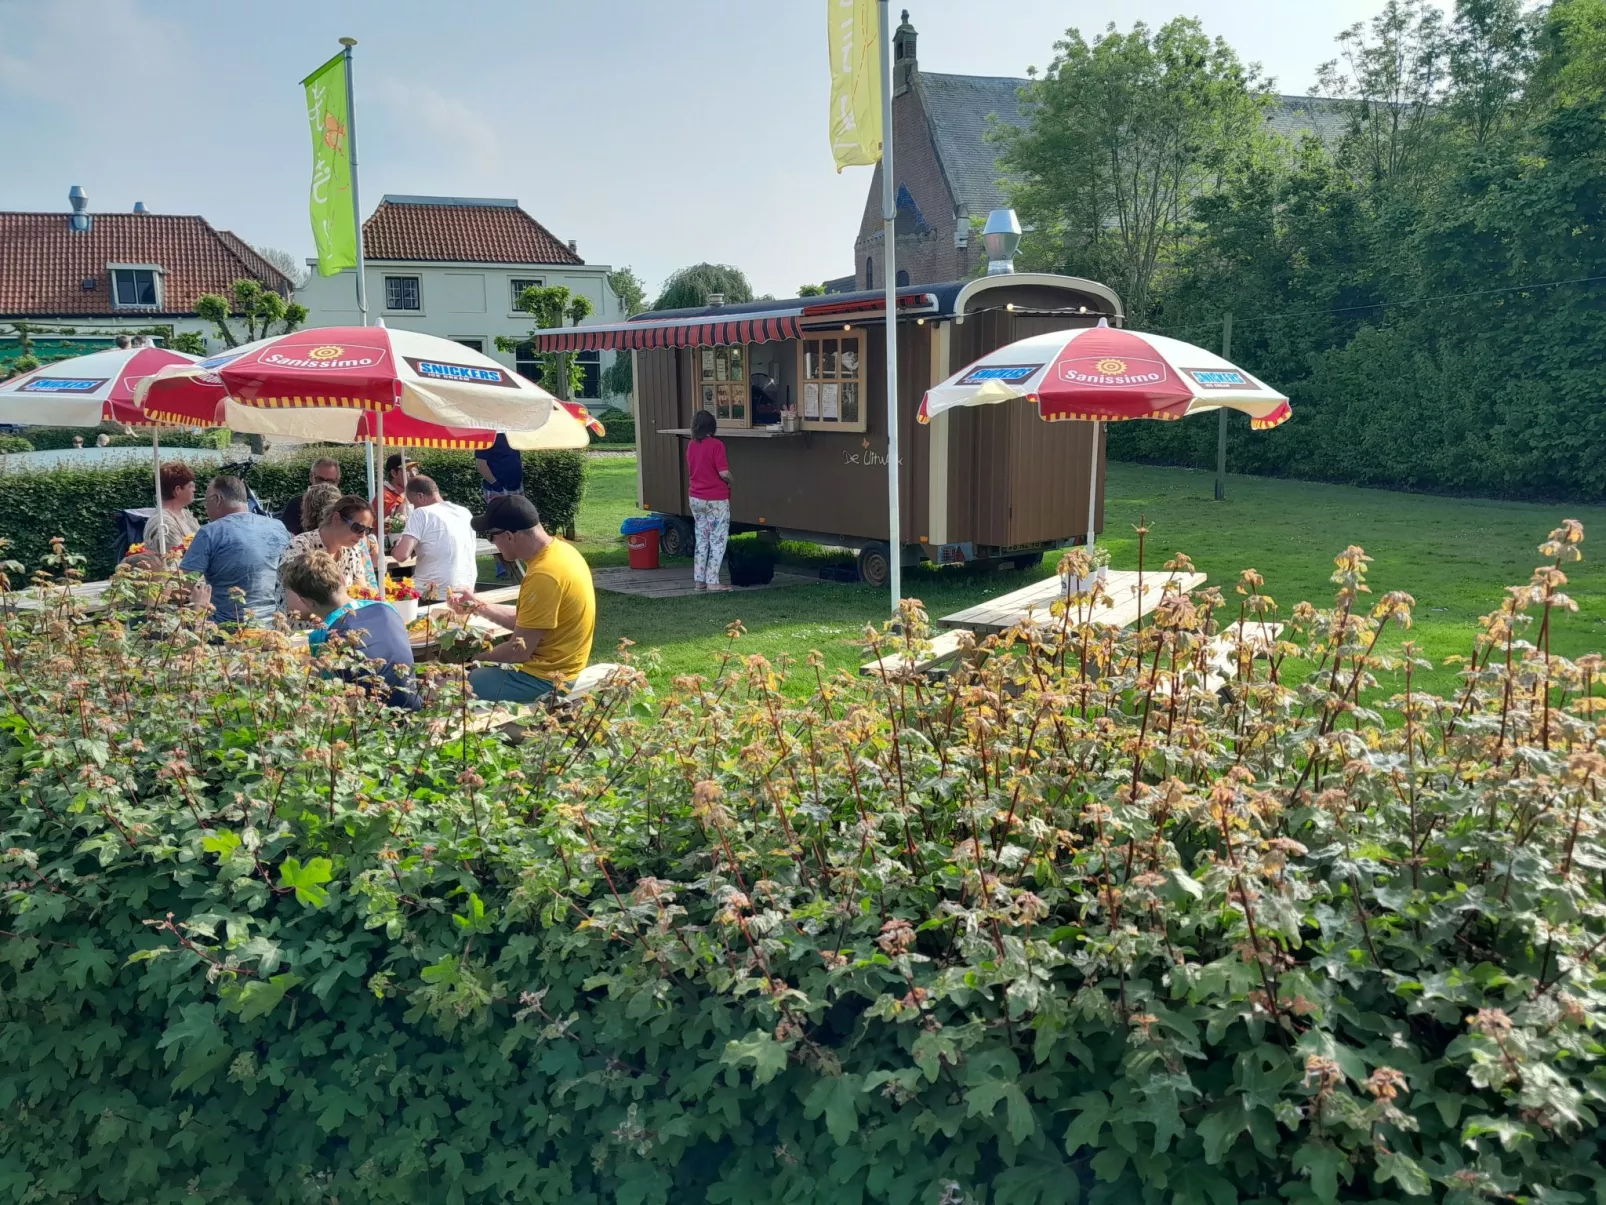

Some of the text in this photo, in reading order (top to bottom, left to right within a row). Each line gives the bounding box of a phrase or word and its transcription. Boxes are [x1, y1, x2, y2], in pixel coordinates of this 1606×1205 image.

[265, 354, 372, 368] Sanissimo
[419, 362, 501, 382] SNICKERS
[1065, 369, 1160, 384] Sanissimo
[842, 449, 860, 465] De
